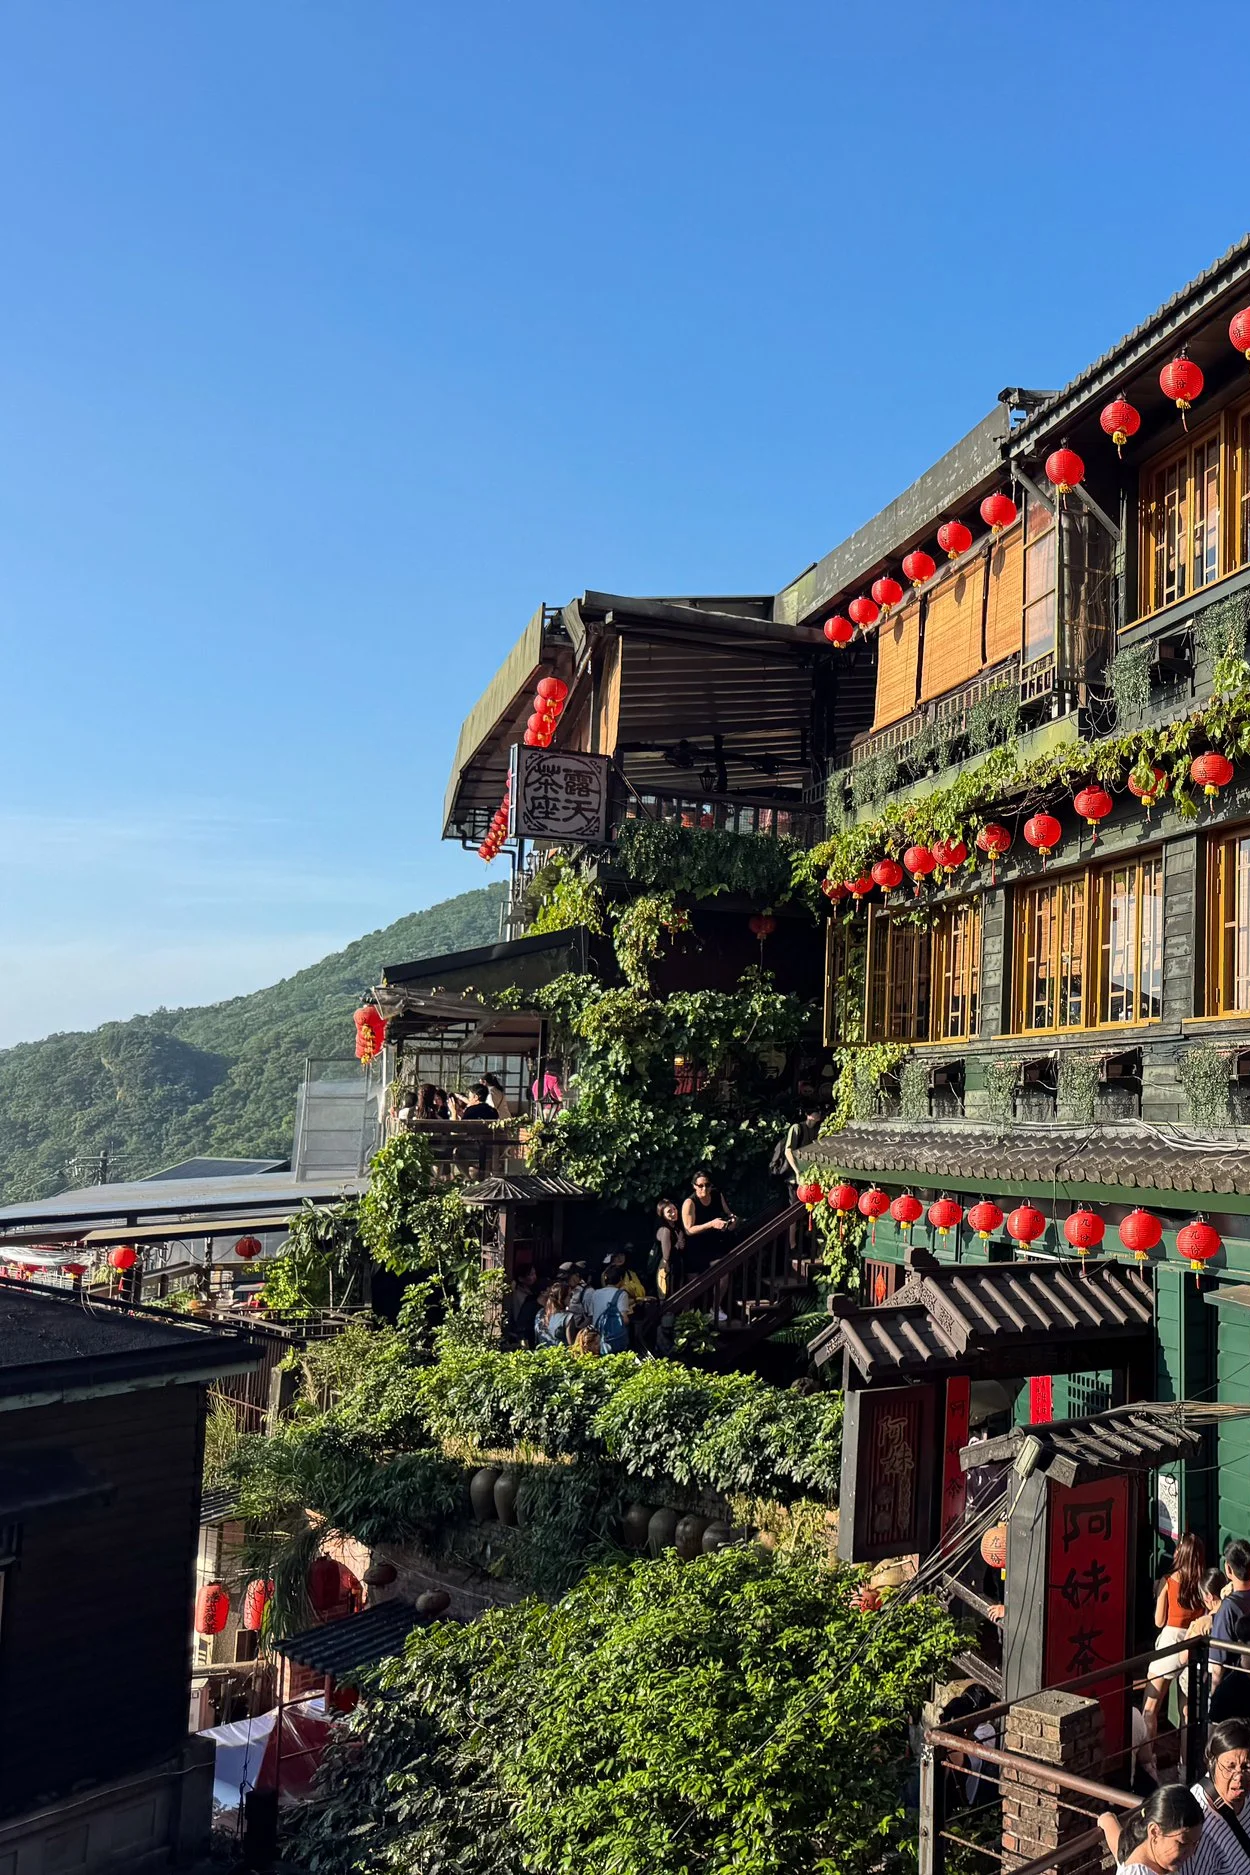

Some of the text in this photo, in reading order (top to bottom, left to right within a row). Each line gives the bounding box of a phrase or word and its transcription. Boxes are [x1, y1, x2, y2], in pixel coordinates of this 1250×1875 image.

[525, 764, 563, 822] 茶座
[562, 767, 600, 824] 露天
[1080, 1218, 1091, 1242] 九份
[1190, 1230, 1200, 1255] 九份
[990, 1536, 1002, 1563] 九份
[1049, 1497, 1116, 1700] 阿妹茶
